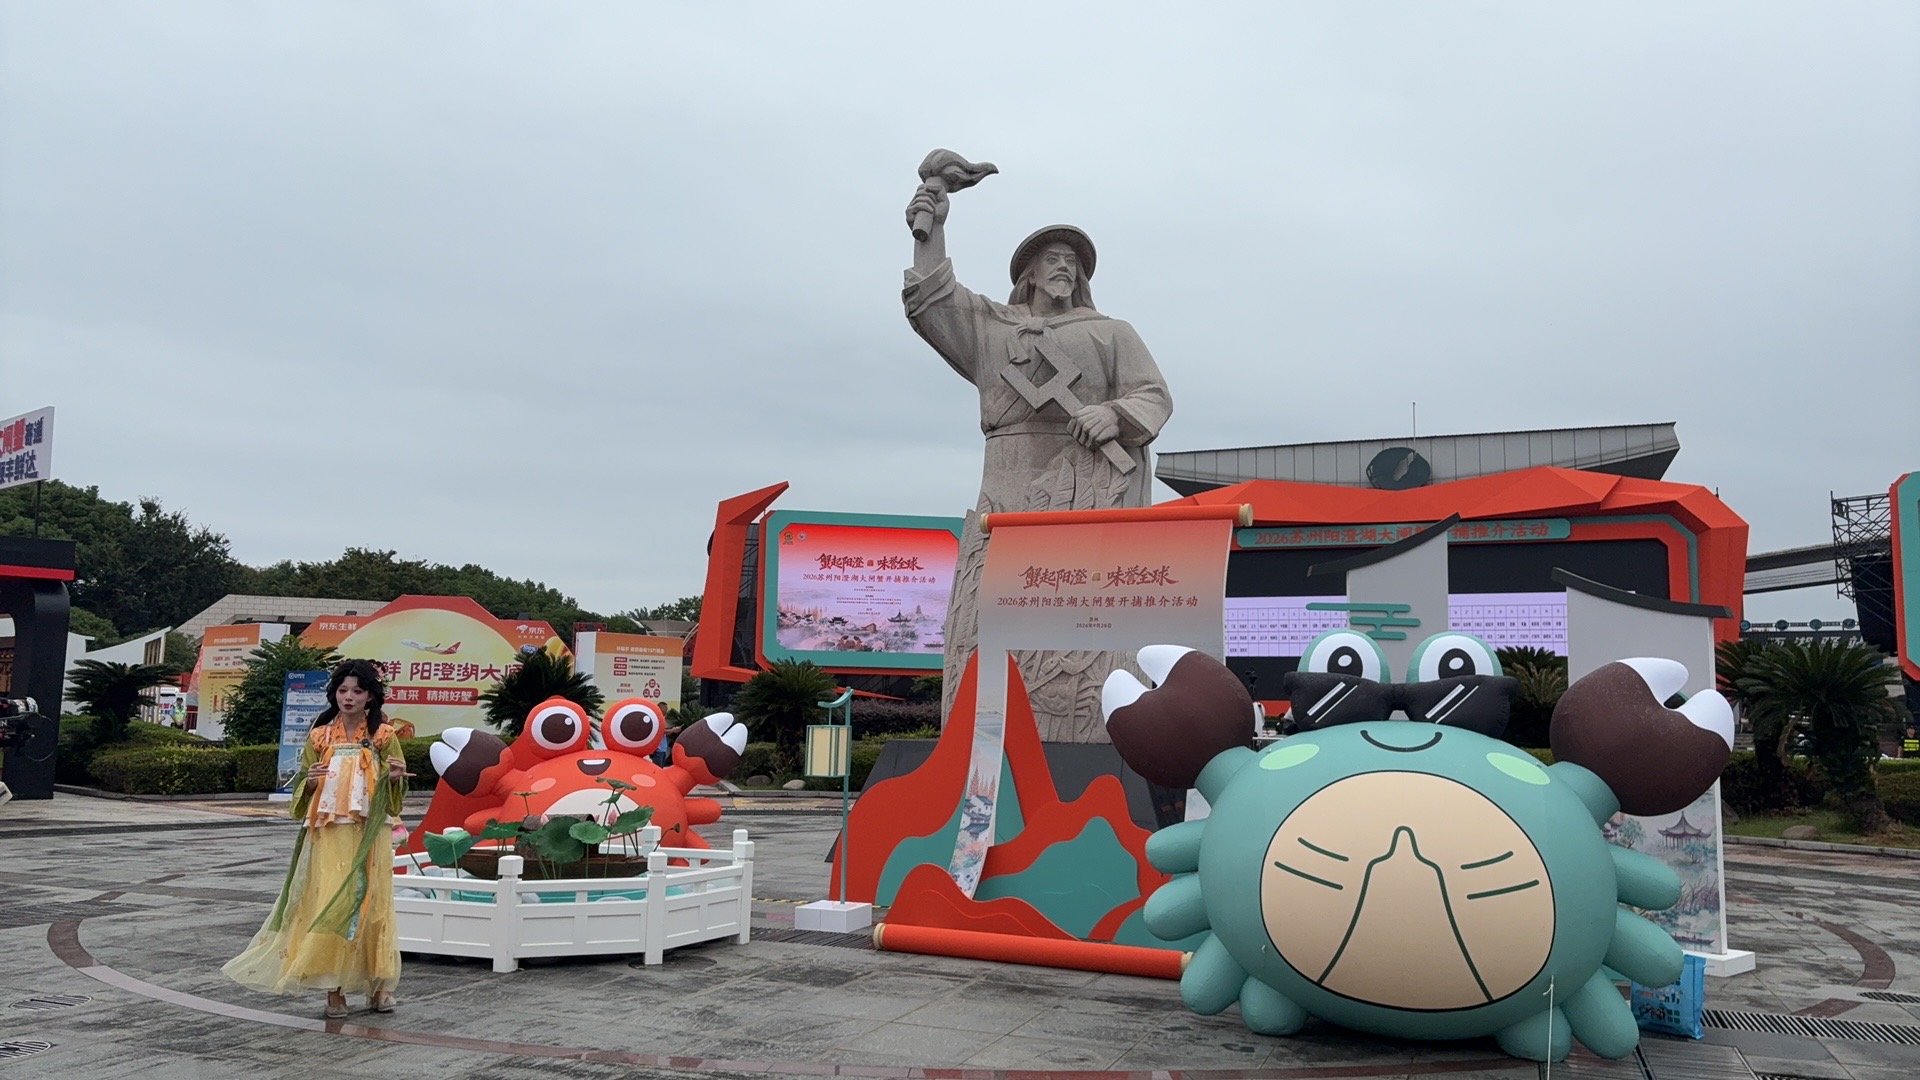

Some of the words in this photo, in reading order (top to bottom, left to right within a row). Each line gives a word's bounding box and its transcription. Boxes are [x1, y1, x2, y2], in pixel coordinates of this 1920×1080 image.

[814, 553, 864, 574] 蟹起阳澄
[873, 554, 925, 572] 味誉全球
[1018, 565, 1088, 594] 蟹起阳澄
[1099, 564, 1179, 590] 味誉全球
[997, 595, 1199, 608] 2026苏州阳澄湖大闸蟹开捕推介活动
[319, 623, 357, 631] 京东生鲜
[528, 626, 545, 635] 京东
[427, 689, 472, 702] 精挑好蟹
